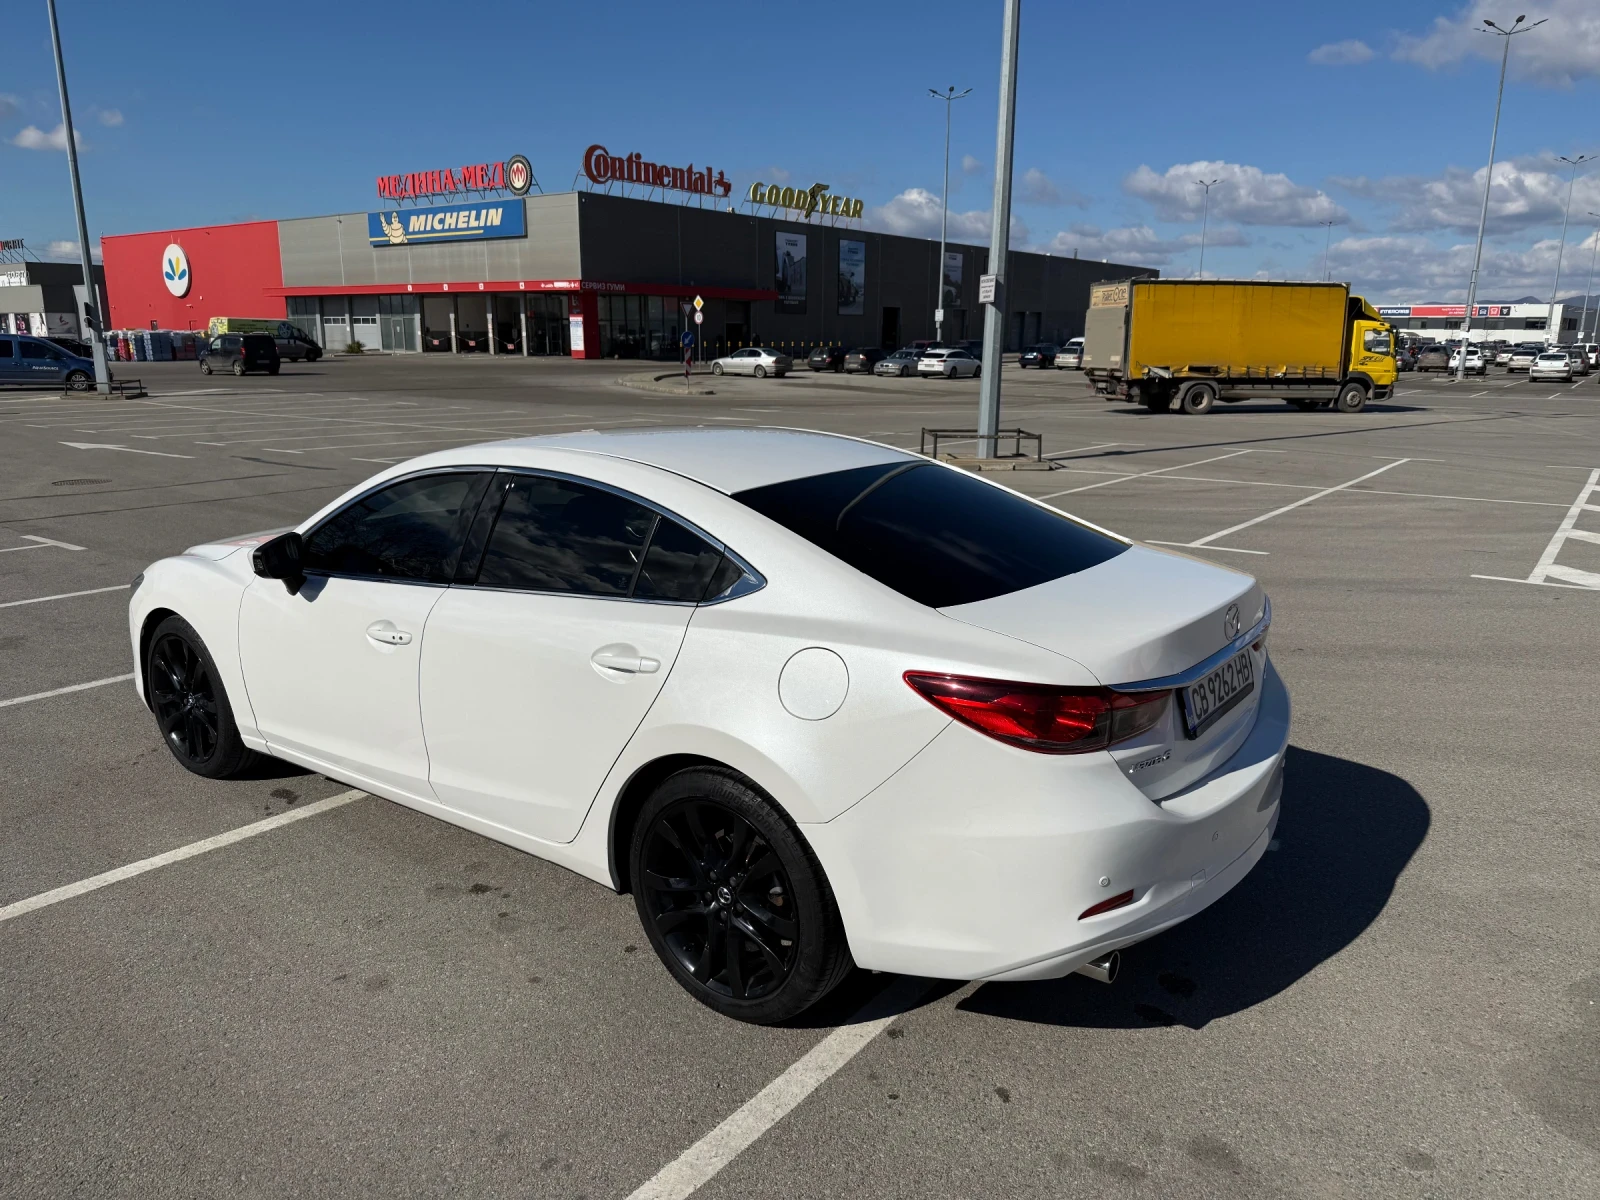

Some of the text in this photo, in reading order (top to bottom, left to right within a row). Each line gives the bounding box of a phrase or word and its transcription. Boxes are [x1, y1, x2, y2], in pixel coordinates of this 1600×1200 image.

[584, 144, 712, 194] Continental
[408, 208, 503, 232] MICHELIN
[606, 283, 625, 291] ГУМИ
[1191, 653, 1250, 721] CB 9262 HB
